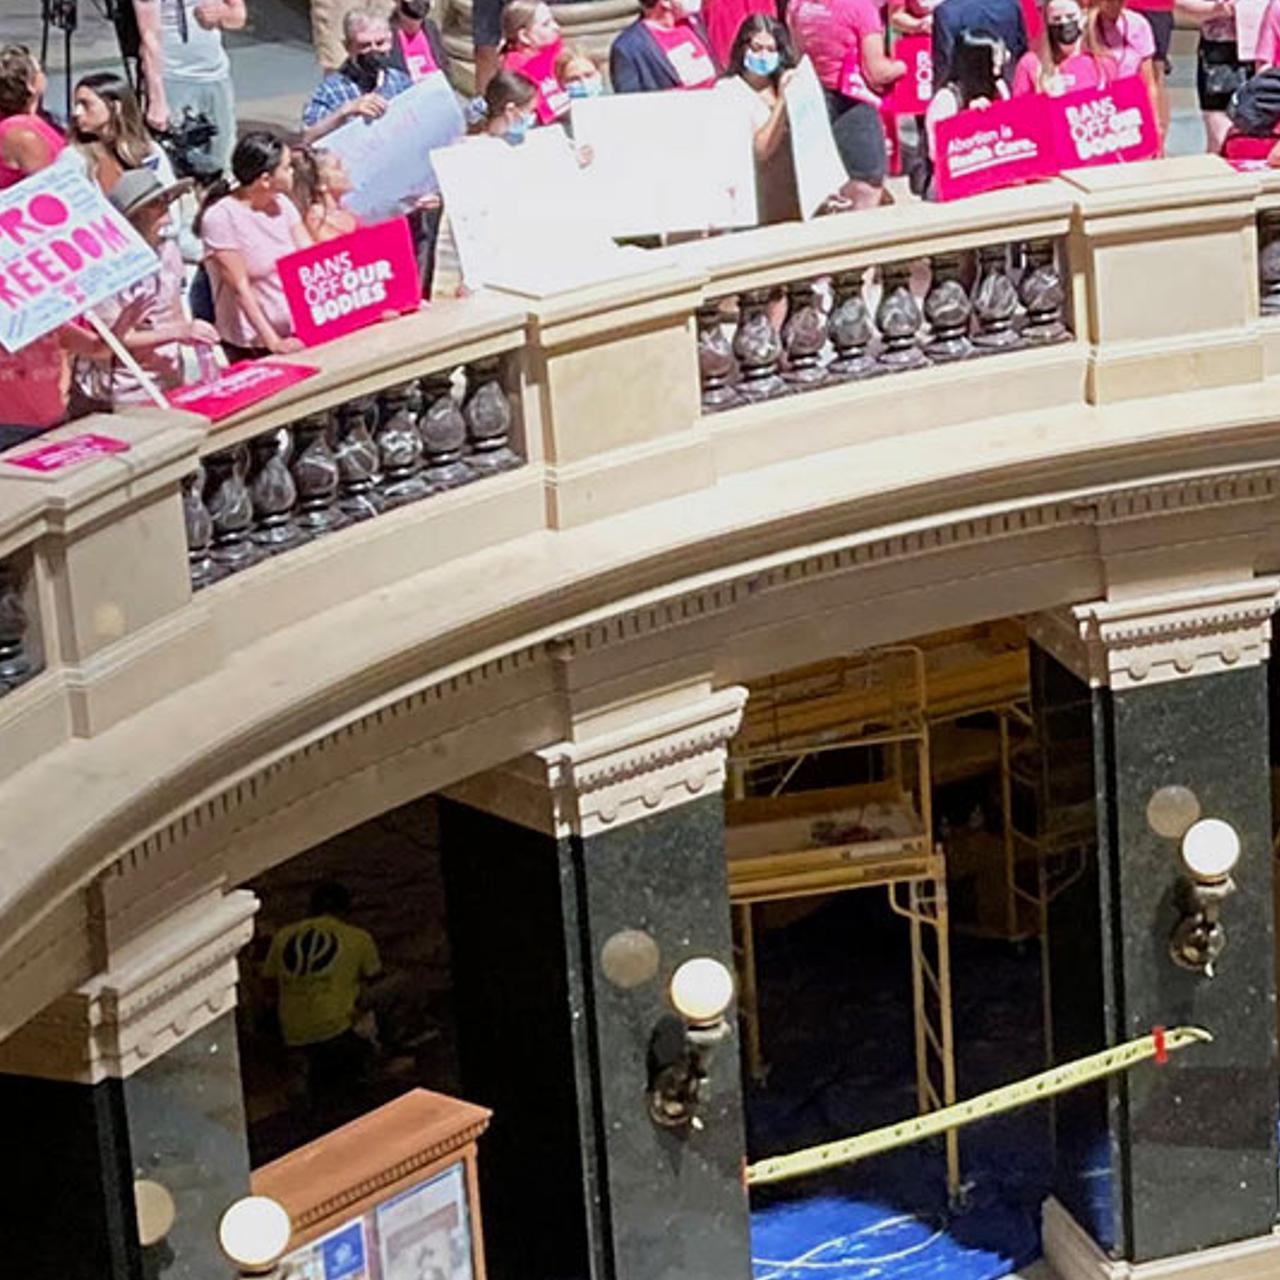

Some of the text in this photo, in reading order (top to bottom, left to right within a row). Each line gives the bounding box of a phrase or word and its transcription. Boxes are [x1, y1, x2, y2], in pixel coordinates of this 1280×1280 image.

[1065, 96, 1116, 120] BANS
[949, 124, 1013, 156] Abortion is
[948, 146, 994, 172] Health
[298, 250, 353, 286] BANS
[303, 258, 395, 306] OFF OUR
[311, 282, 387, 327] BODIES
